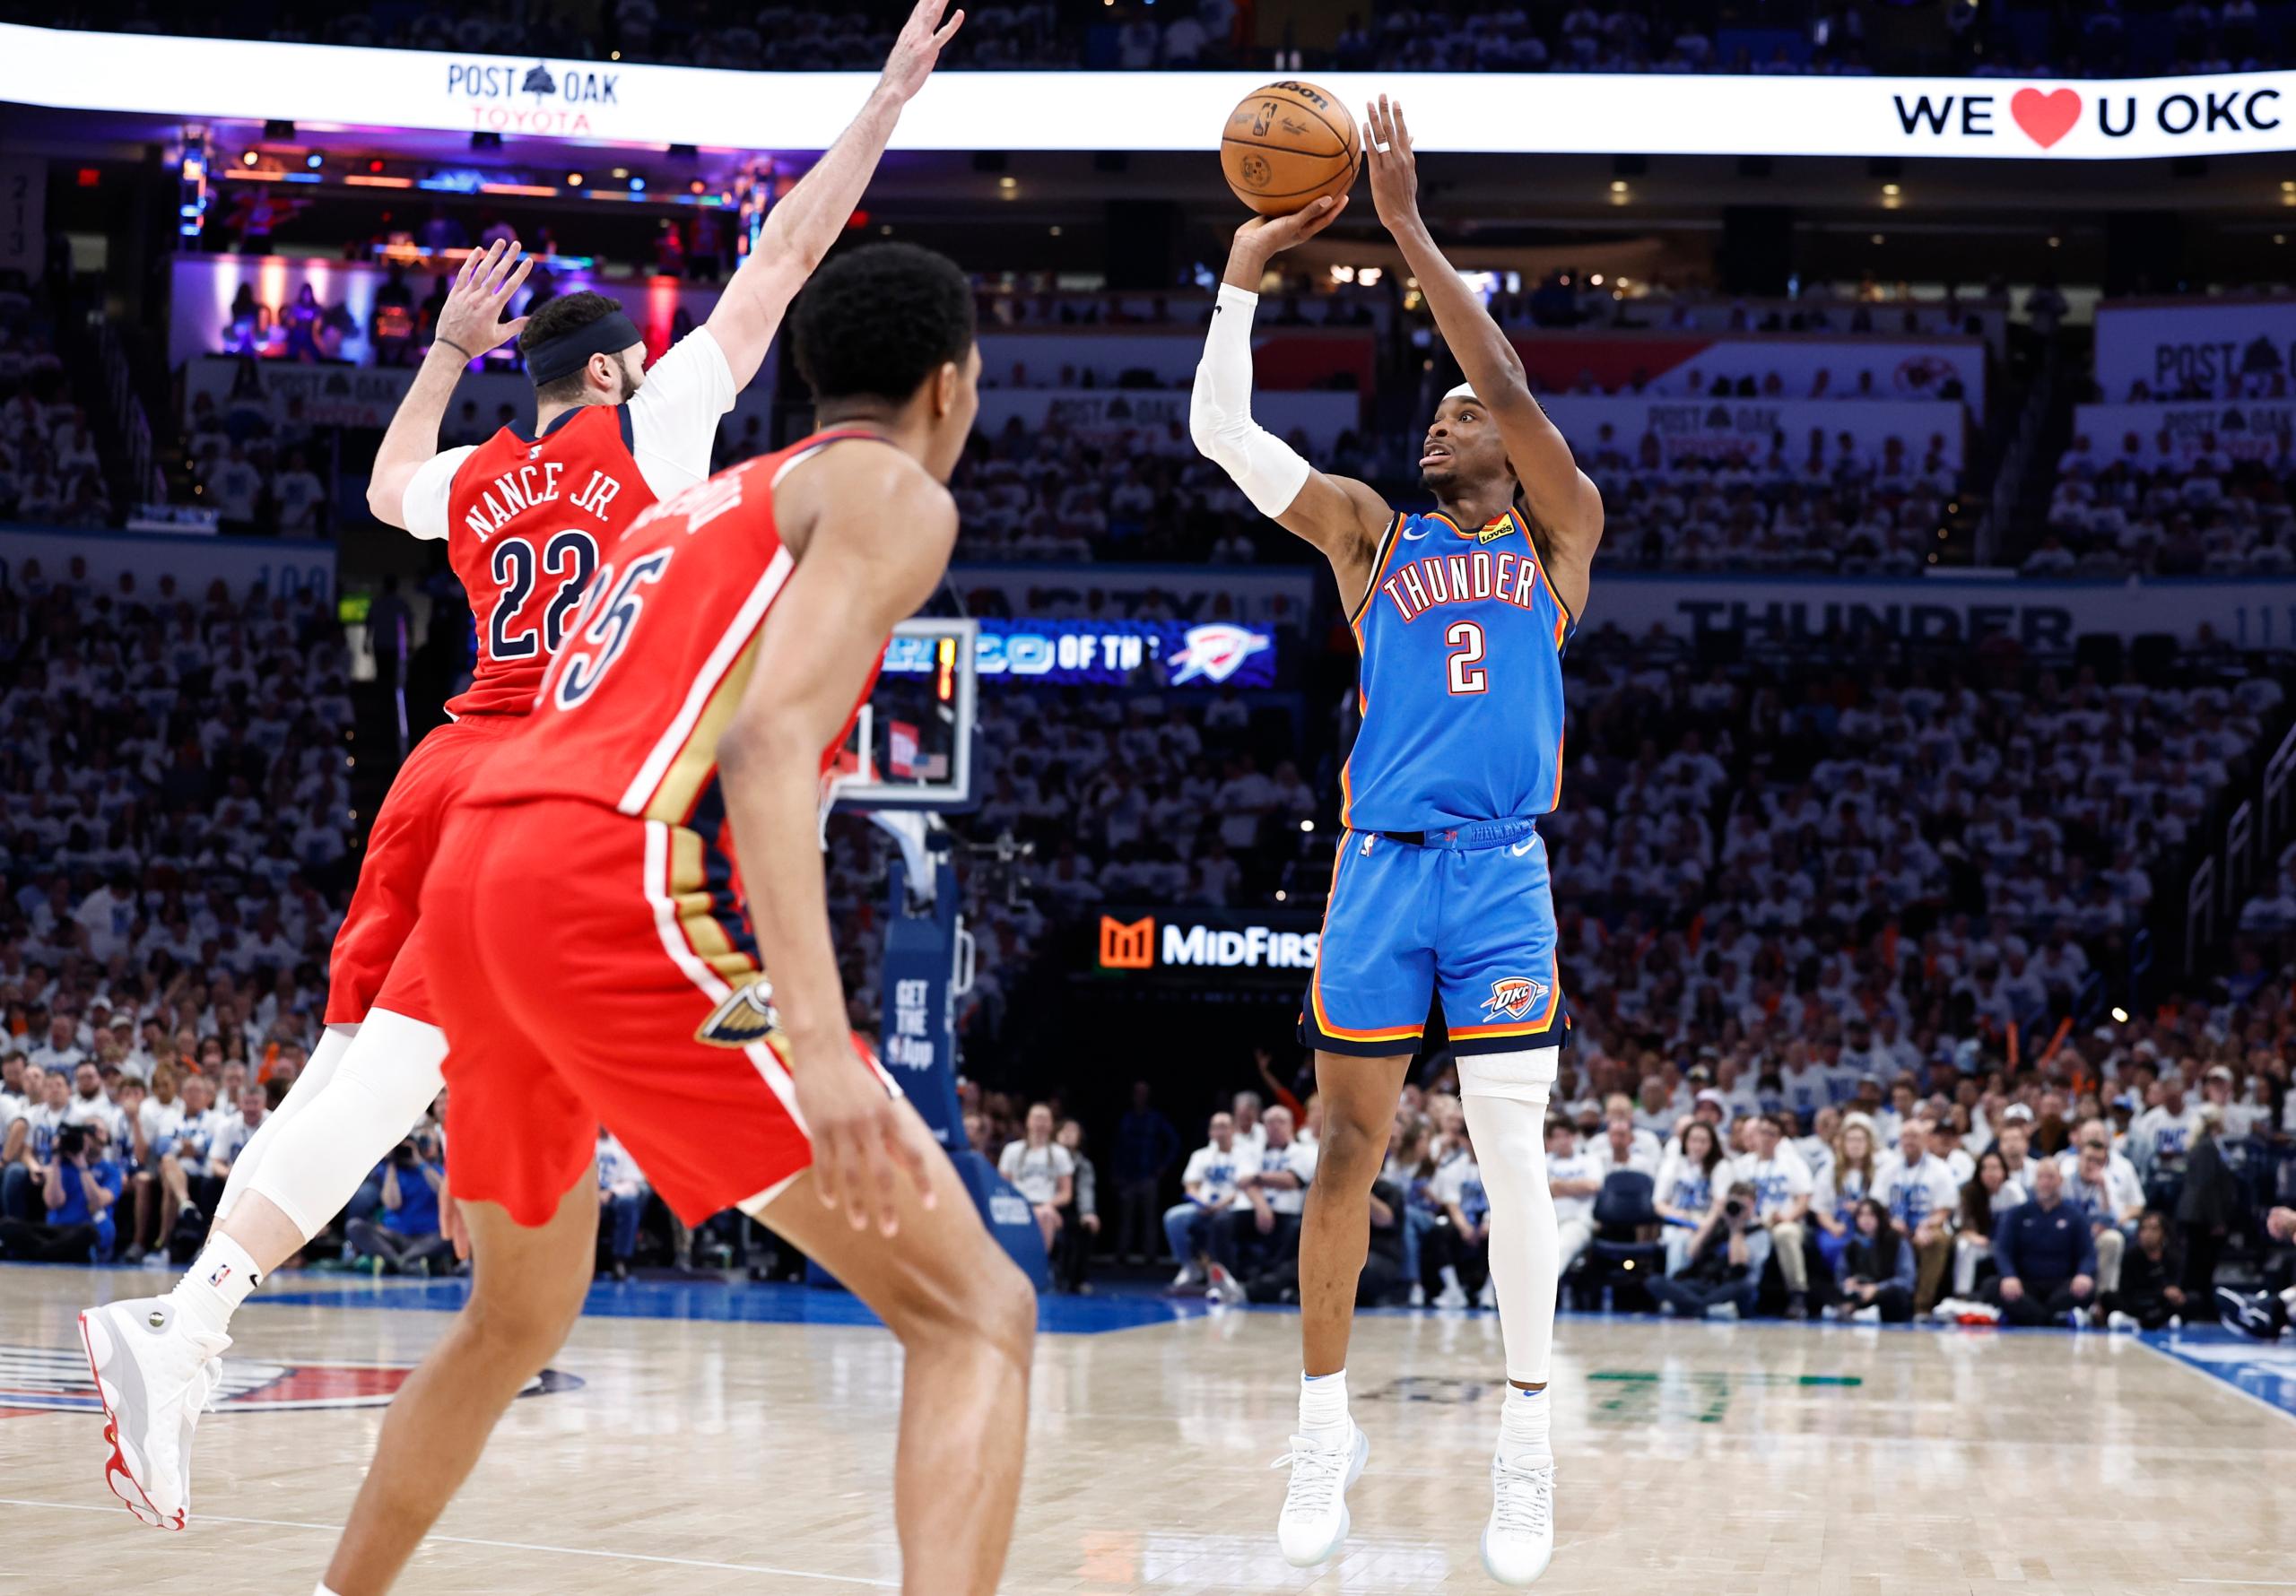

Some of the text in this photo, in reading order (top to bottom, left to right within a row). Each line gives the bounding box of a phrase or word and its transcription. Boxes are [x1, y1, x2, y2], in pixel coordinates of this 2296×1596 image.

[448, 64, 620, 105] POST OAK
[472, 106, 591, 135] TOYOTA
[1893, 89, 2281, 137] WE U OKC
[465, 462, 564, 543] NANCE
[570, 470, 621, 522] JR.
[489, 528, 600, 662] 22
[1381, 551, 1539, 624] THUNDER
[1677, 600, 2073, 649] THUNDER
[1057, 633, 1098, 671] OF
[1445, 620, 1489, 697] 2
[1494, 985, 1529, 1011] OKC
